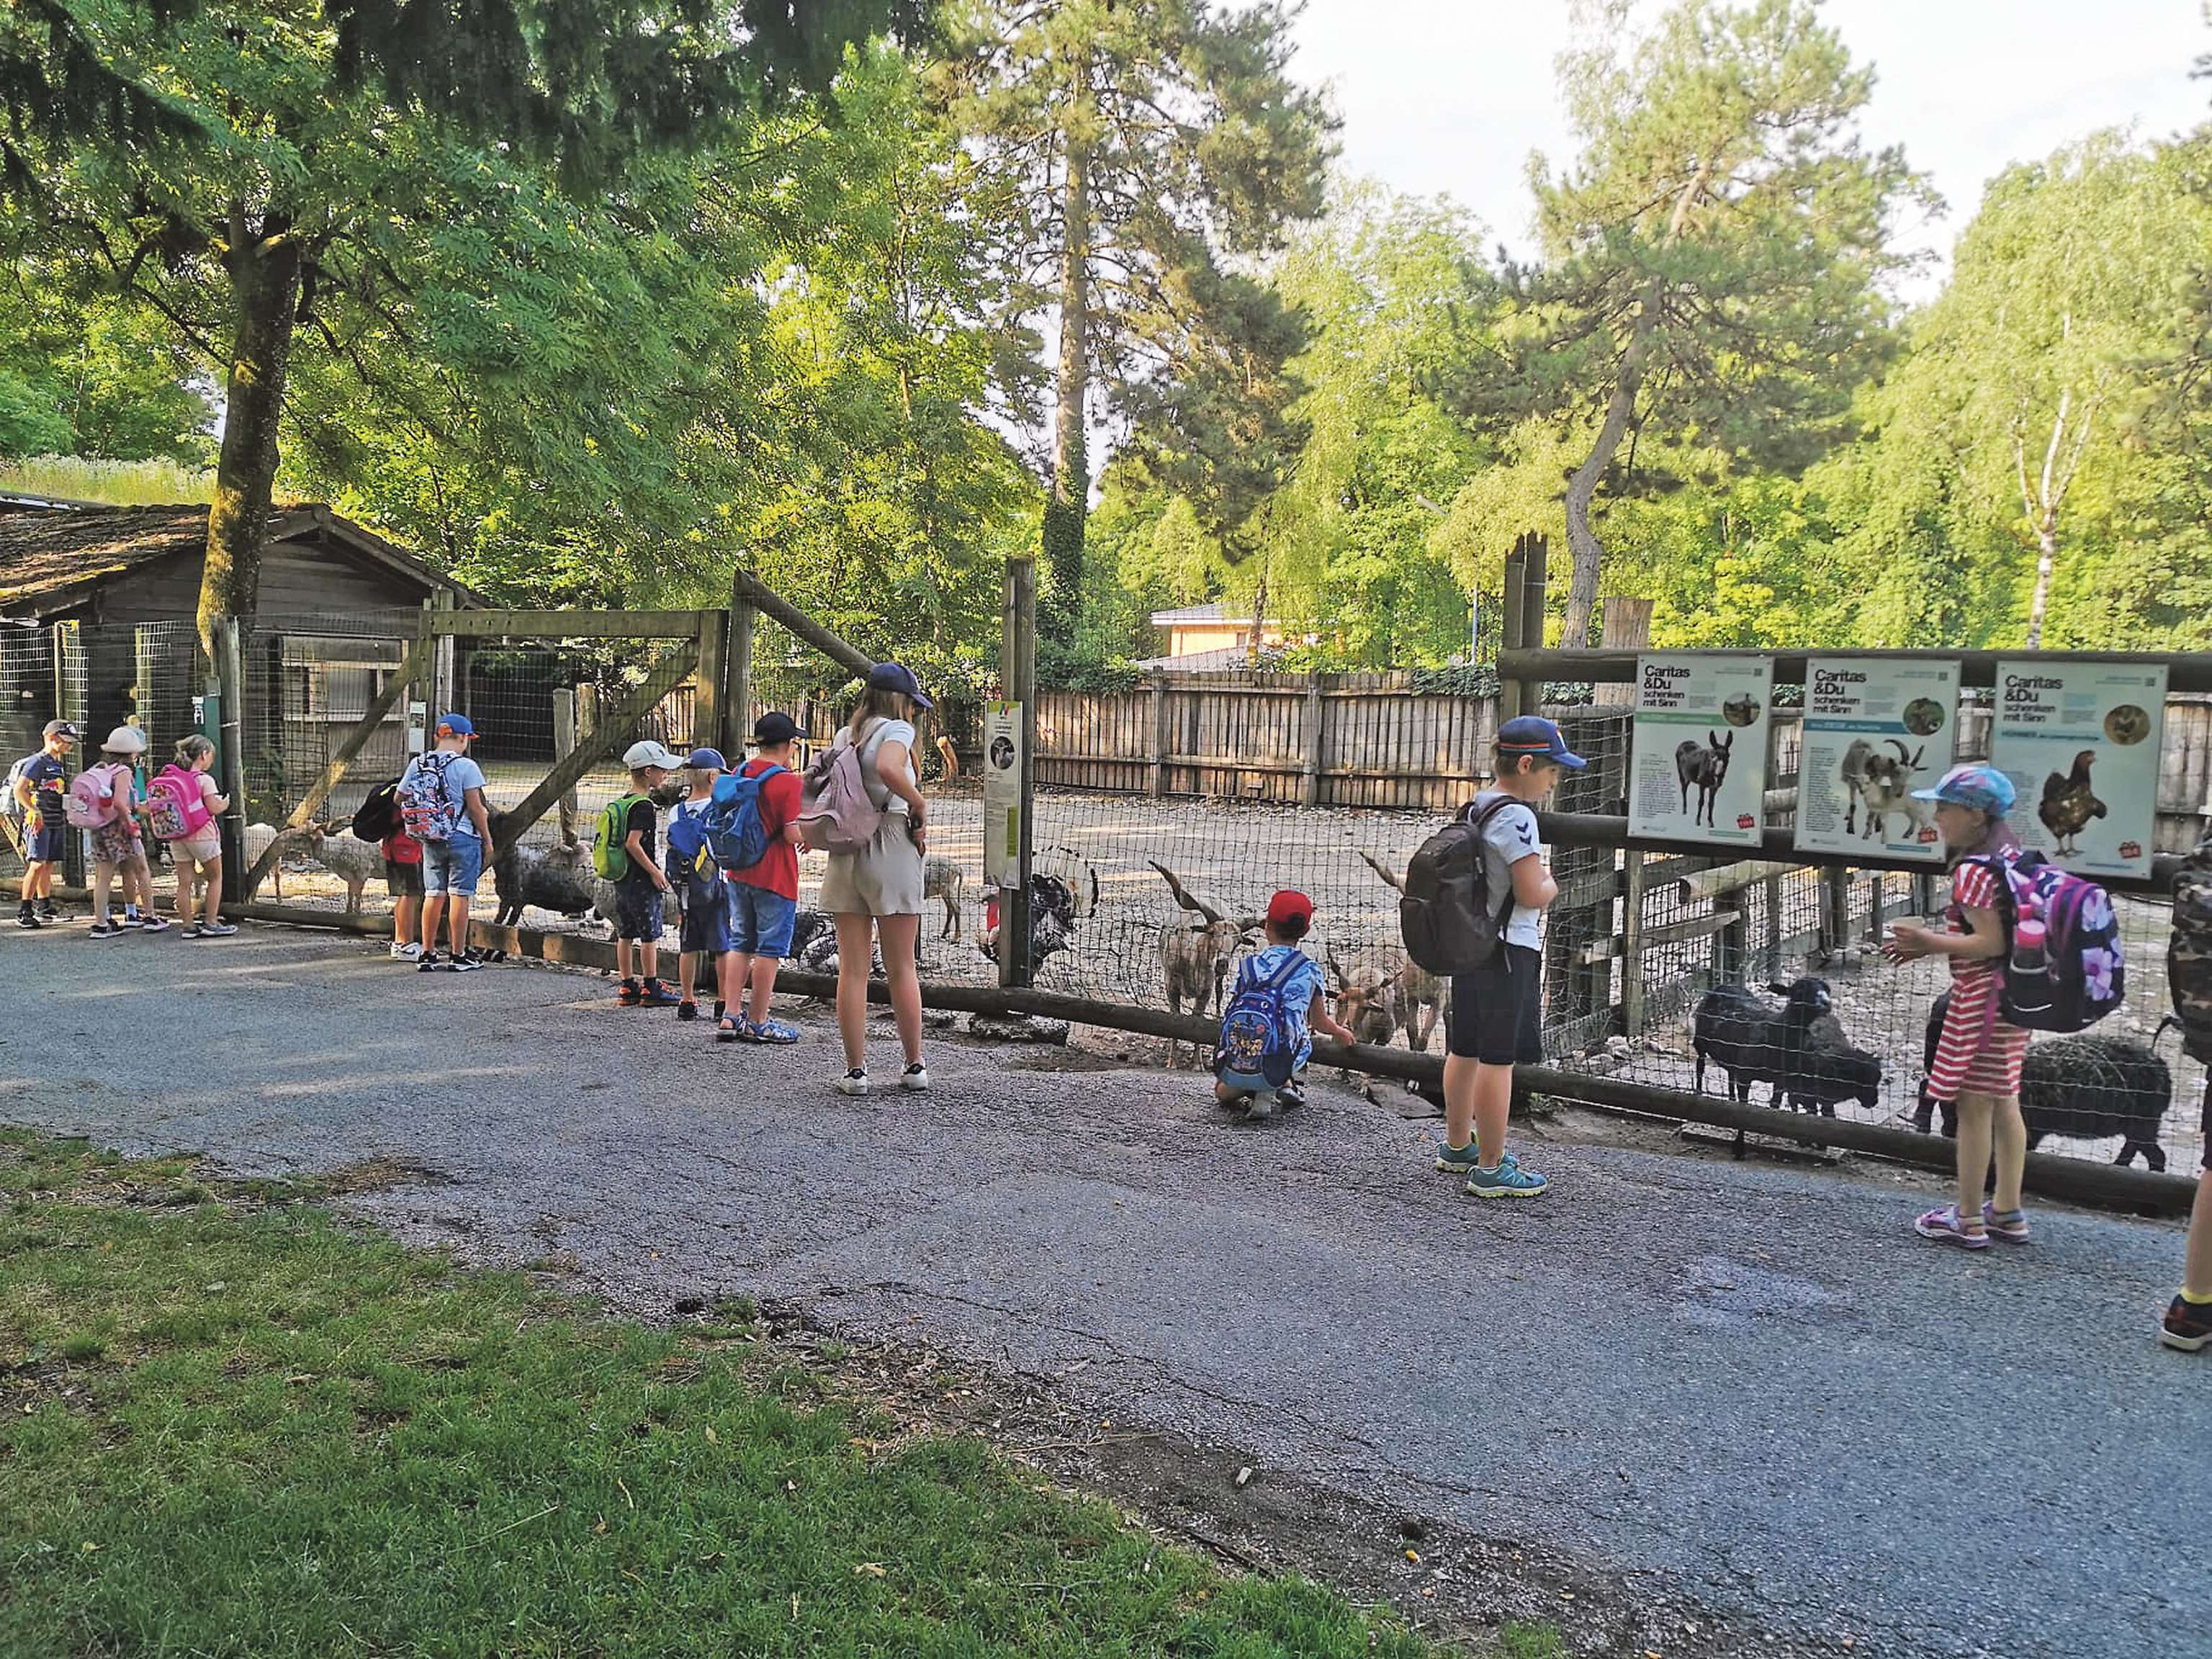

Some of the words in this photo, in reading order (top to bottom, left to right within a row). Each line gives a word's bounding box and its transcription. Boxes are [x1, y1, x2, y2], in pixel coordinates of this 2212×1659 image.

[1645, 665, 1690, 678] Caritas
[1815, 669, 1867, 683] Caritas
[1643, 678, 1671, 690] &Du
[2005, 675, 2064, 689] Caritas
[1814, 682, 1845, 696] &Du
[1643, 691, 1685, 699] schenken
[1813, 696, 1861, 705] schenken
[2004, 688, 2039, 703] &Du
[1642, 698, 1656, 707] mit
[1658, 698, 1678, 708] Sinn
[2004, 703, 2056, 713] schenken
[1813, 705, 1829, 714] mit
[1831, 705, 1852, 714] Sinn
[2003, 713, 2020, 721] mit
[2023, 713, 2046, 723] Sinn
